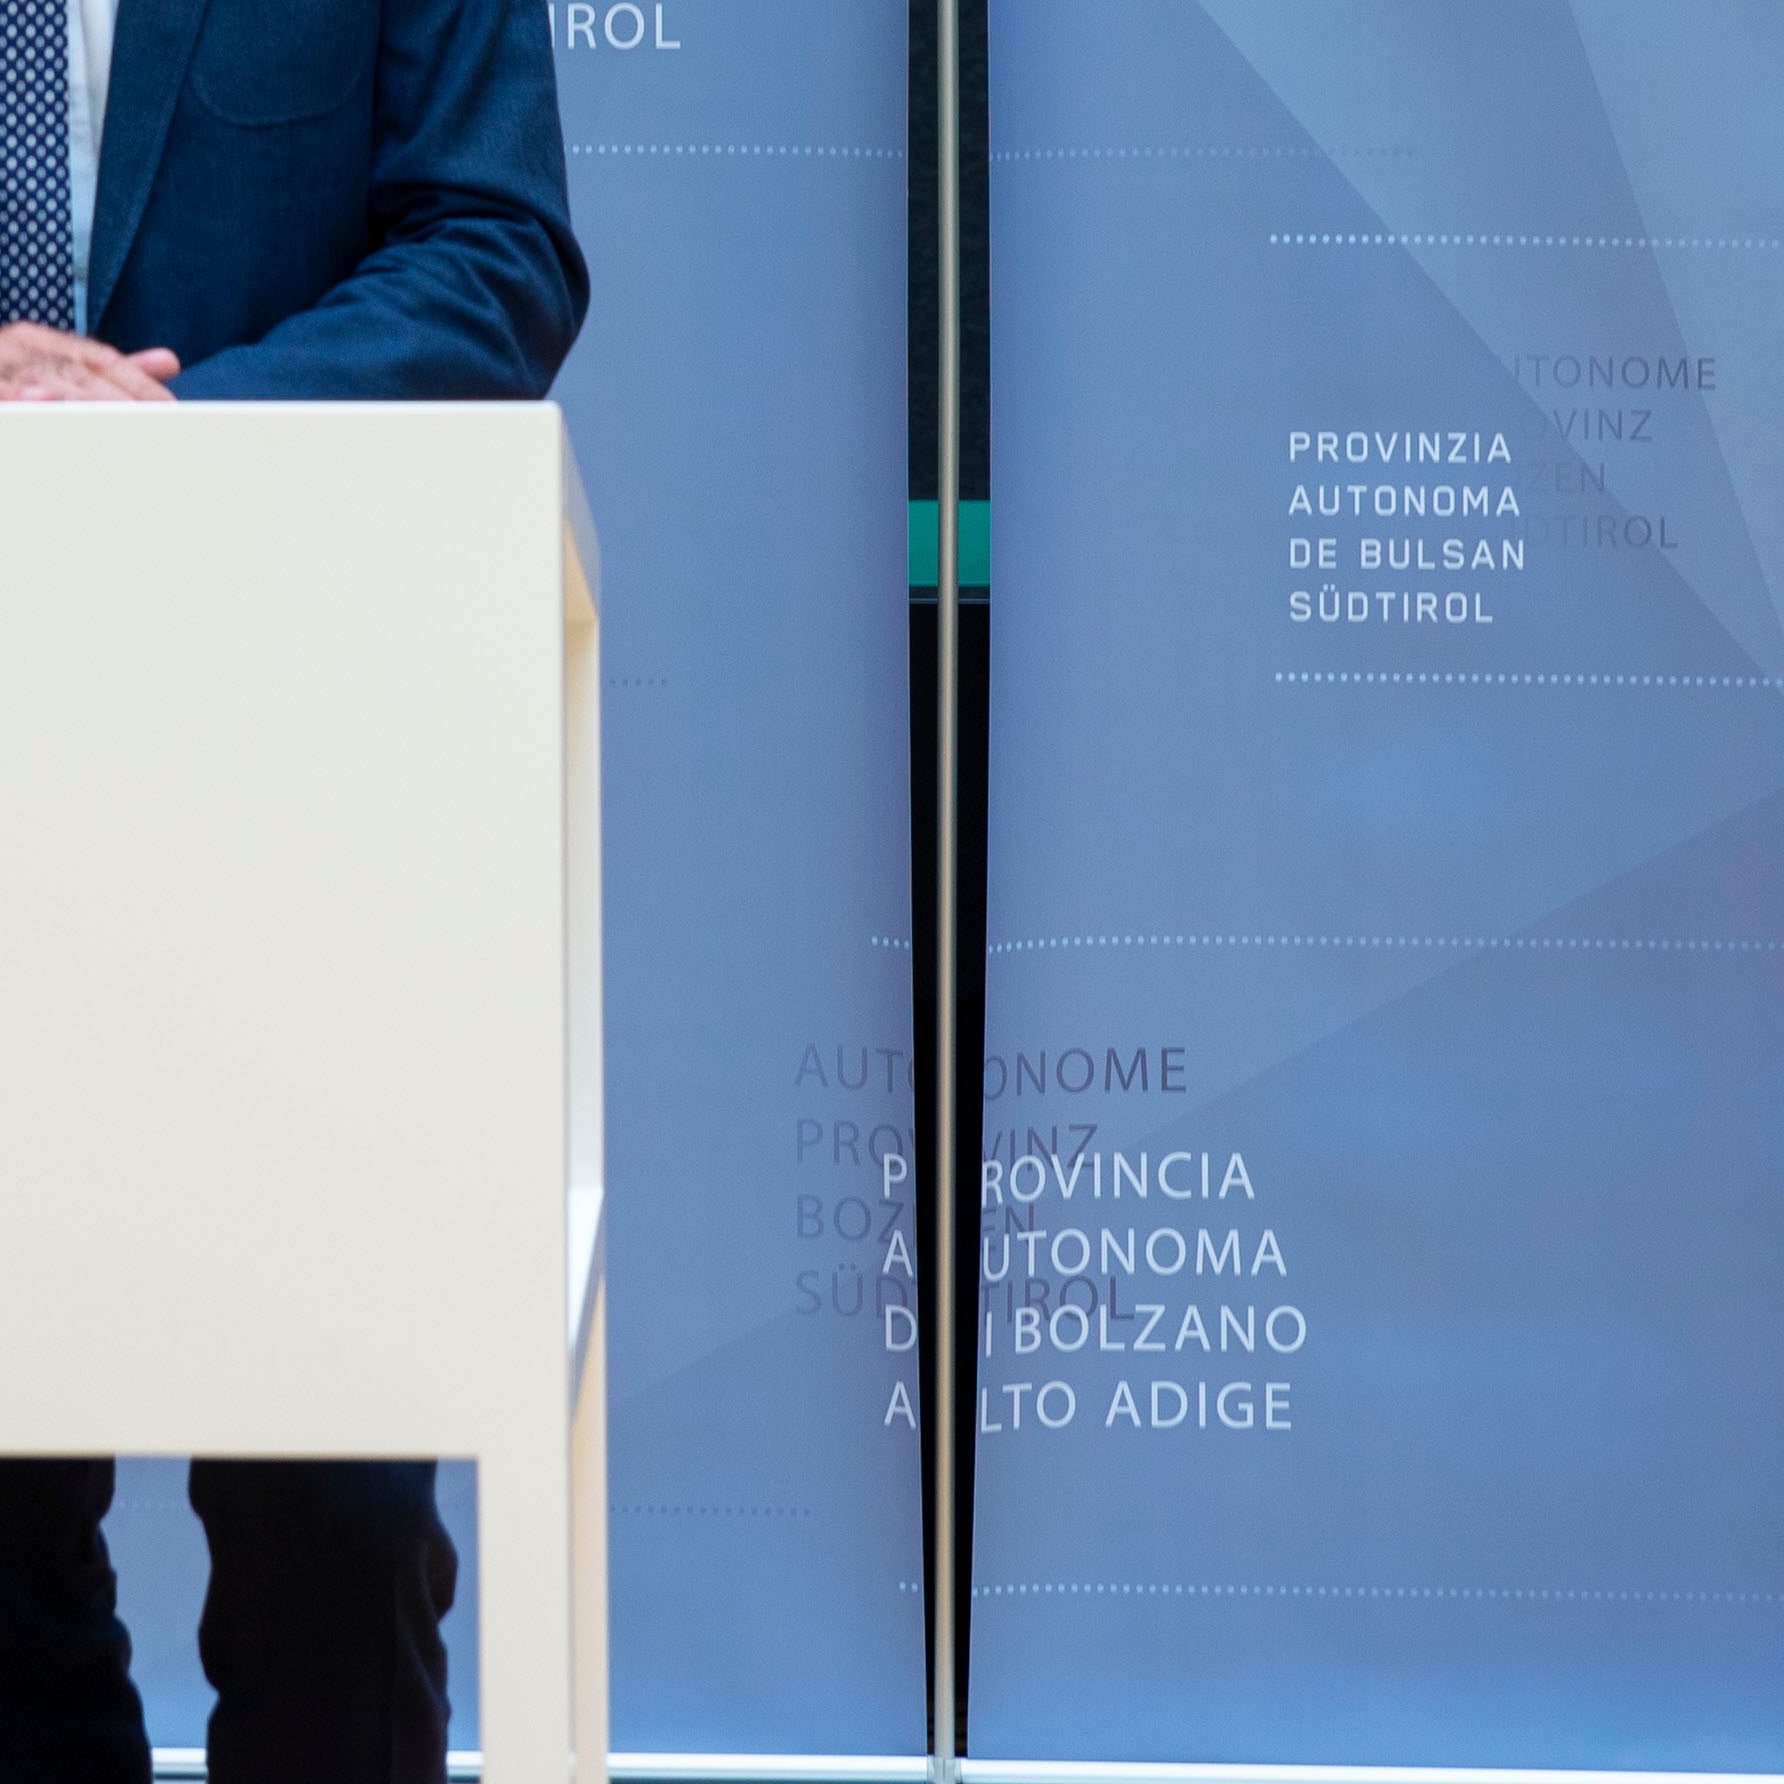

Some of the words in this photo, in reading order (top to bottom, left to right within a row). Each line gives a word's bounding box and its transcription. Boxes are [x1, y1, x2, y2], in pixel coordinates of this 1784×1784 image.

[1289, 431, 1512, 463] PROVINZIA
[1288, 485, 1520, 517] AUTONOMA
[1289, 538, 1337, 570] DE
[1361, 538, 1525, 571] BULSAN
[1289, 584, 1493, 624] SÜDTIROL
[1014, 1304, 1307, 1354] BOLZANO
[1106, 1380, 1292, 1430] ADIGE
